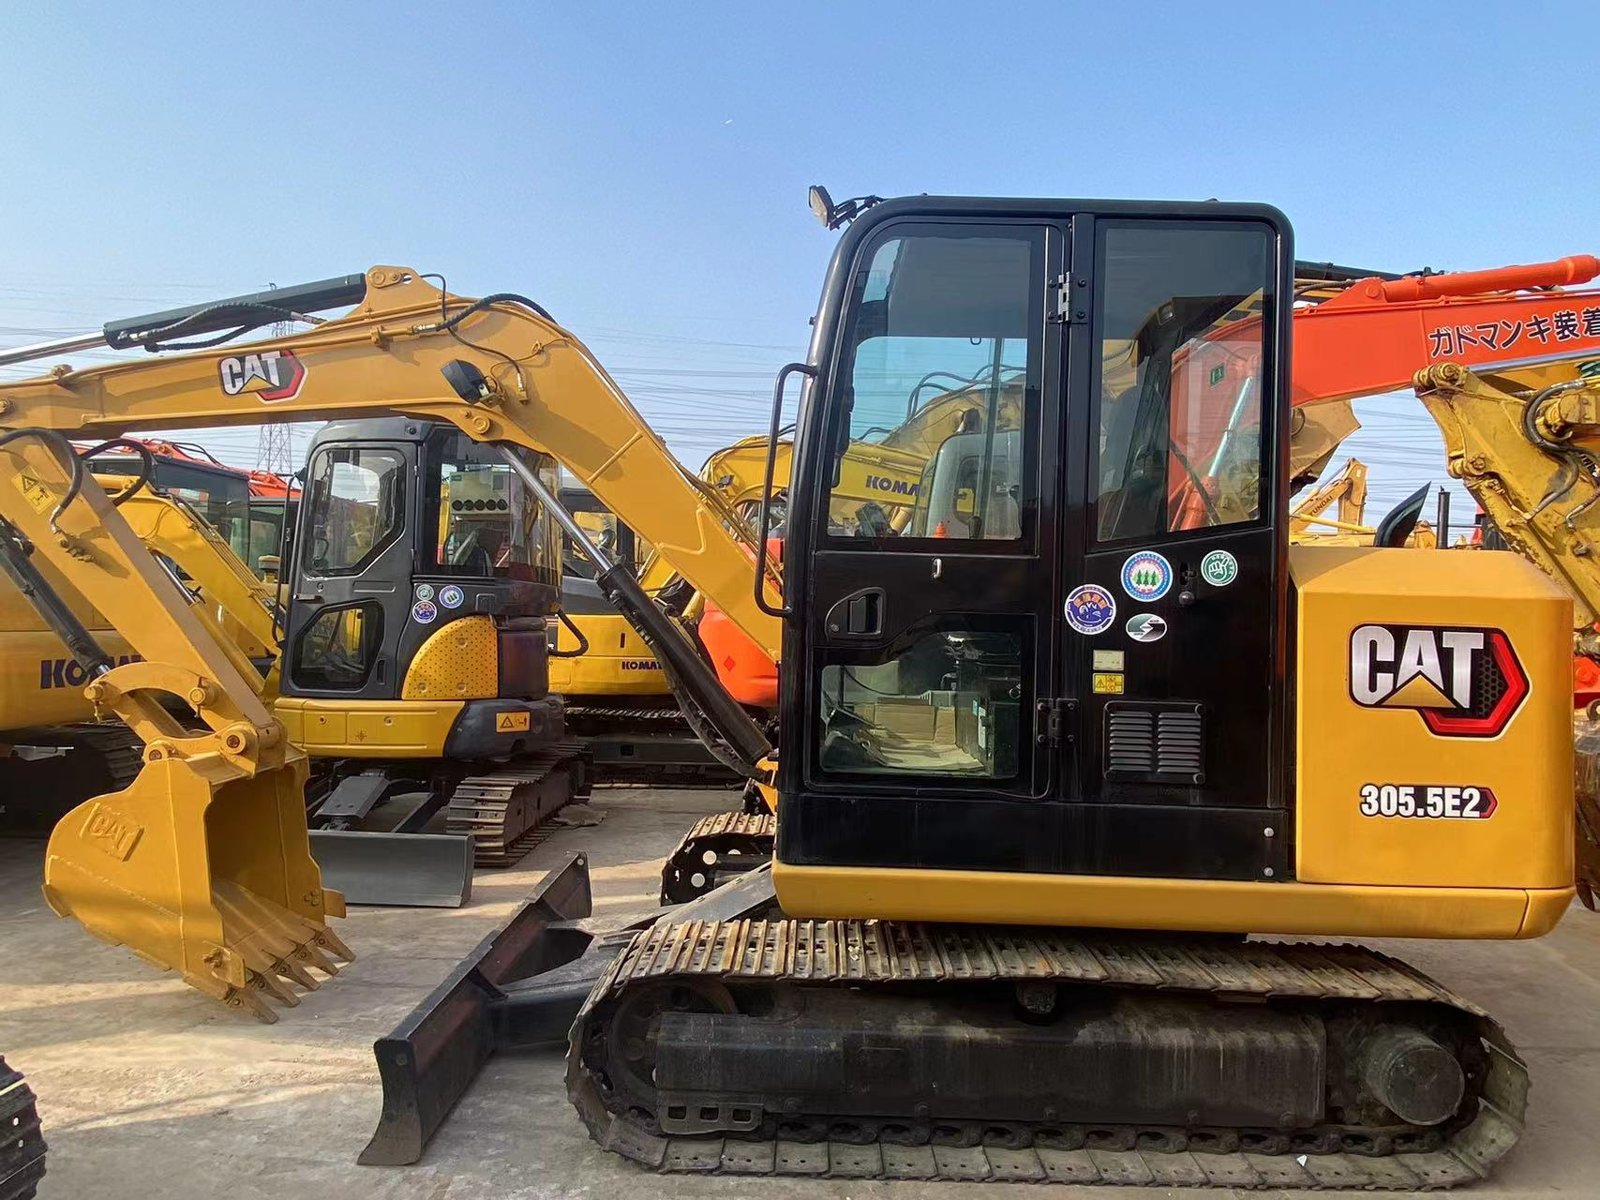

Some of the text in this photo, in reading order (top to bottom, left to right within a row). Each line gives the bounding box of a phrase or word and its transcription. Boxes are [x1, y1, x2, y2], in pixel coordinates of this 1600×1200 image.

[220, 350, 281, 395] CAT
[1351, 625, 1485, 709] CAT
[1360, 784, 1481, 818] 305.5E2
[88, 811, 137, 852] CAT
